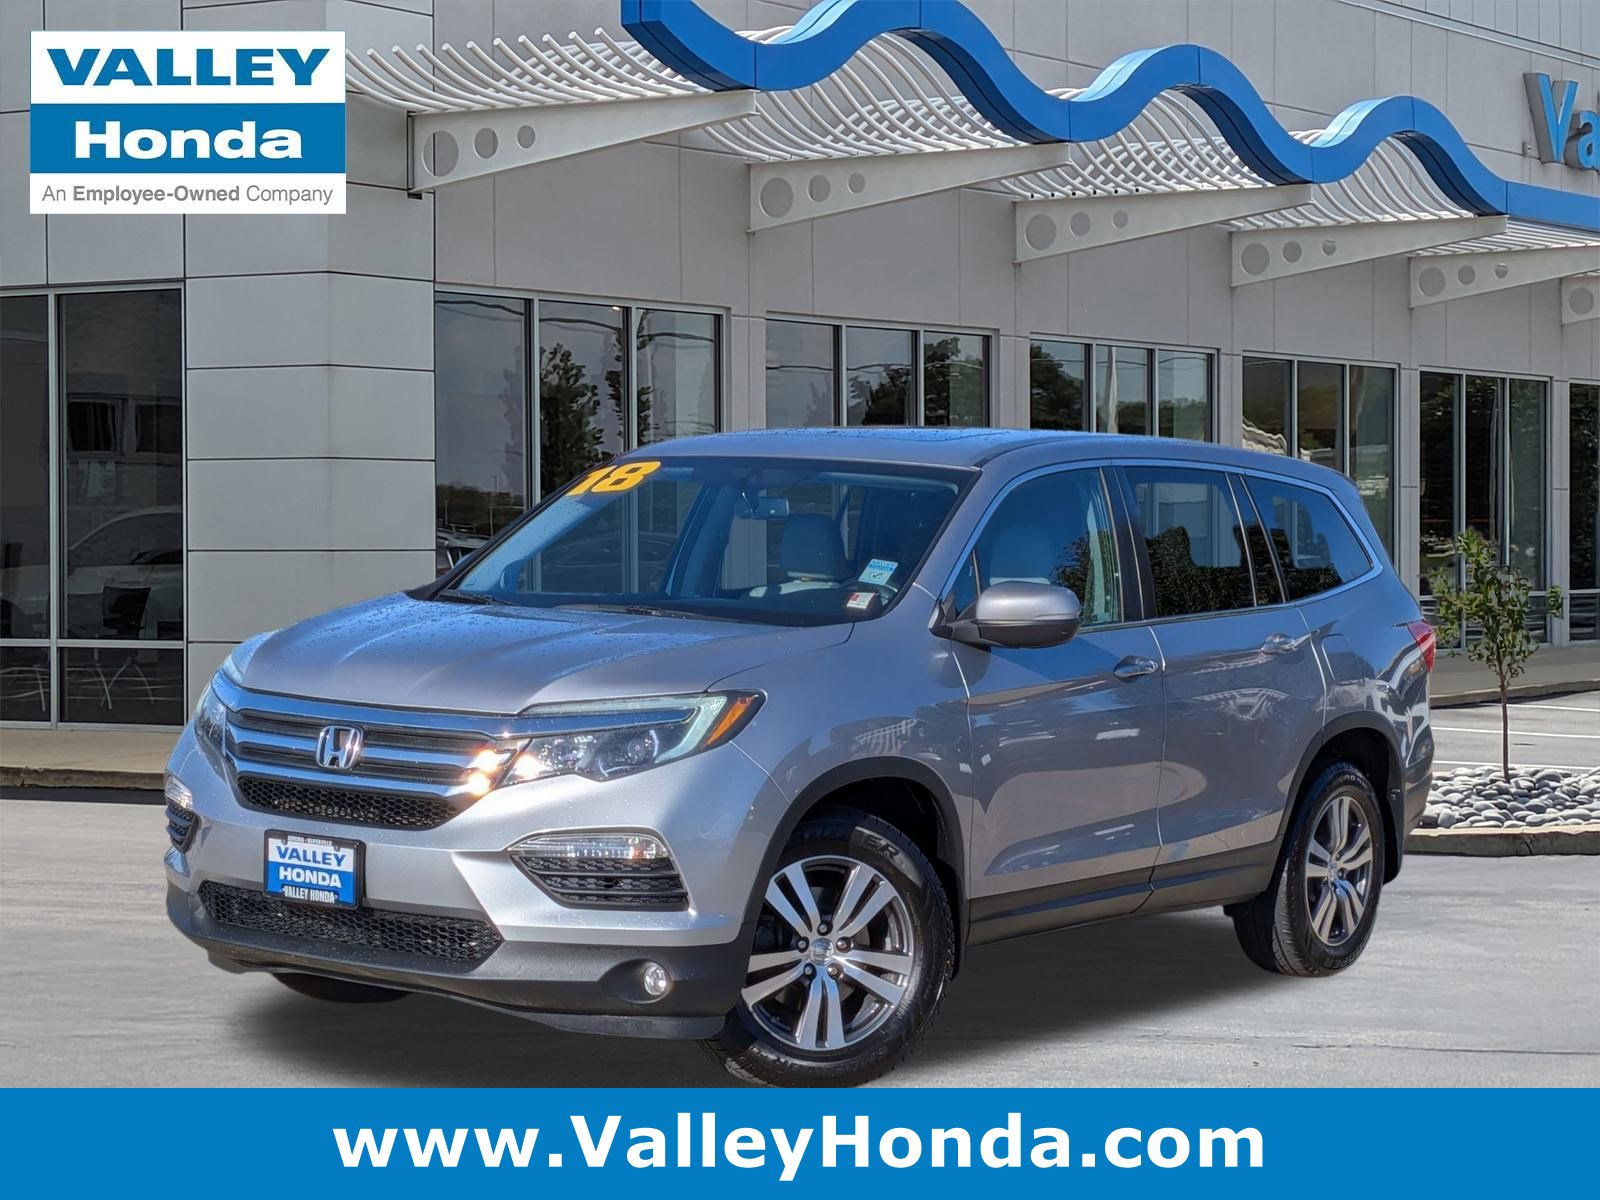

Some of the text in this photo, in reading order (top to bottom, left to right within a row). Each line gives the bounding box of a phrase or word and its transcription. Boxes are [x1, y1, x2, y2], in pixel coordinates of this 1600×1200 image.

[565, 461, 661, 496] 18
[276, 845, 346, 867] VALLEY
[279, 866, 342, 888] HONDA
[284, 885, 335, 904] VALLEY HONDA
